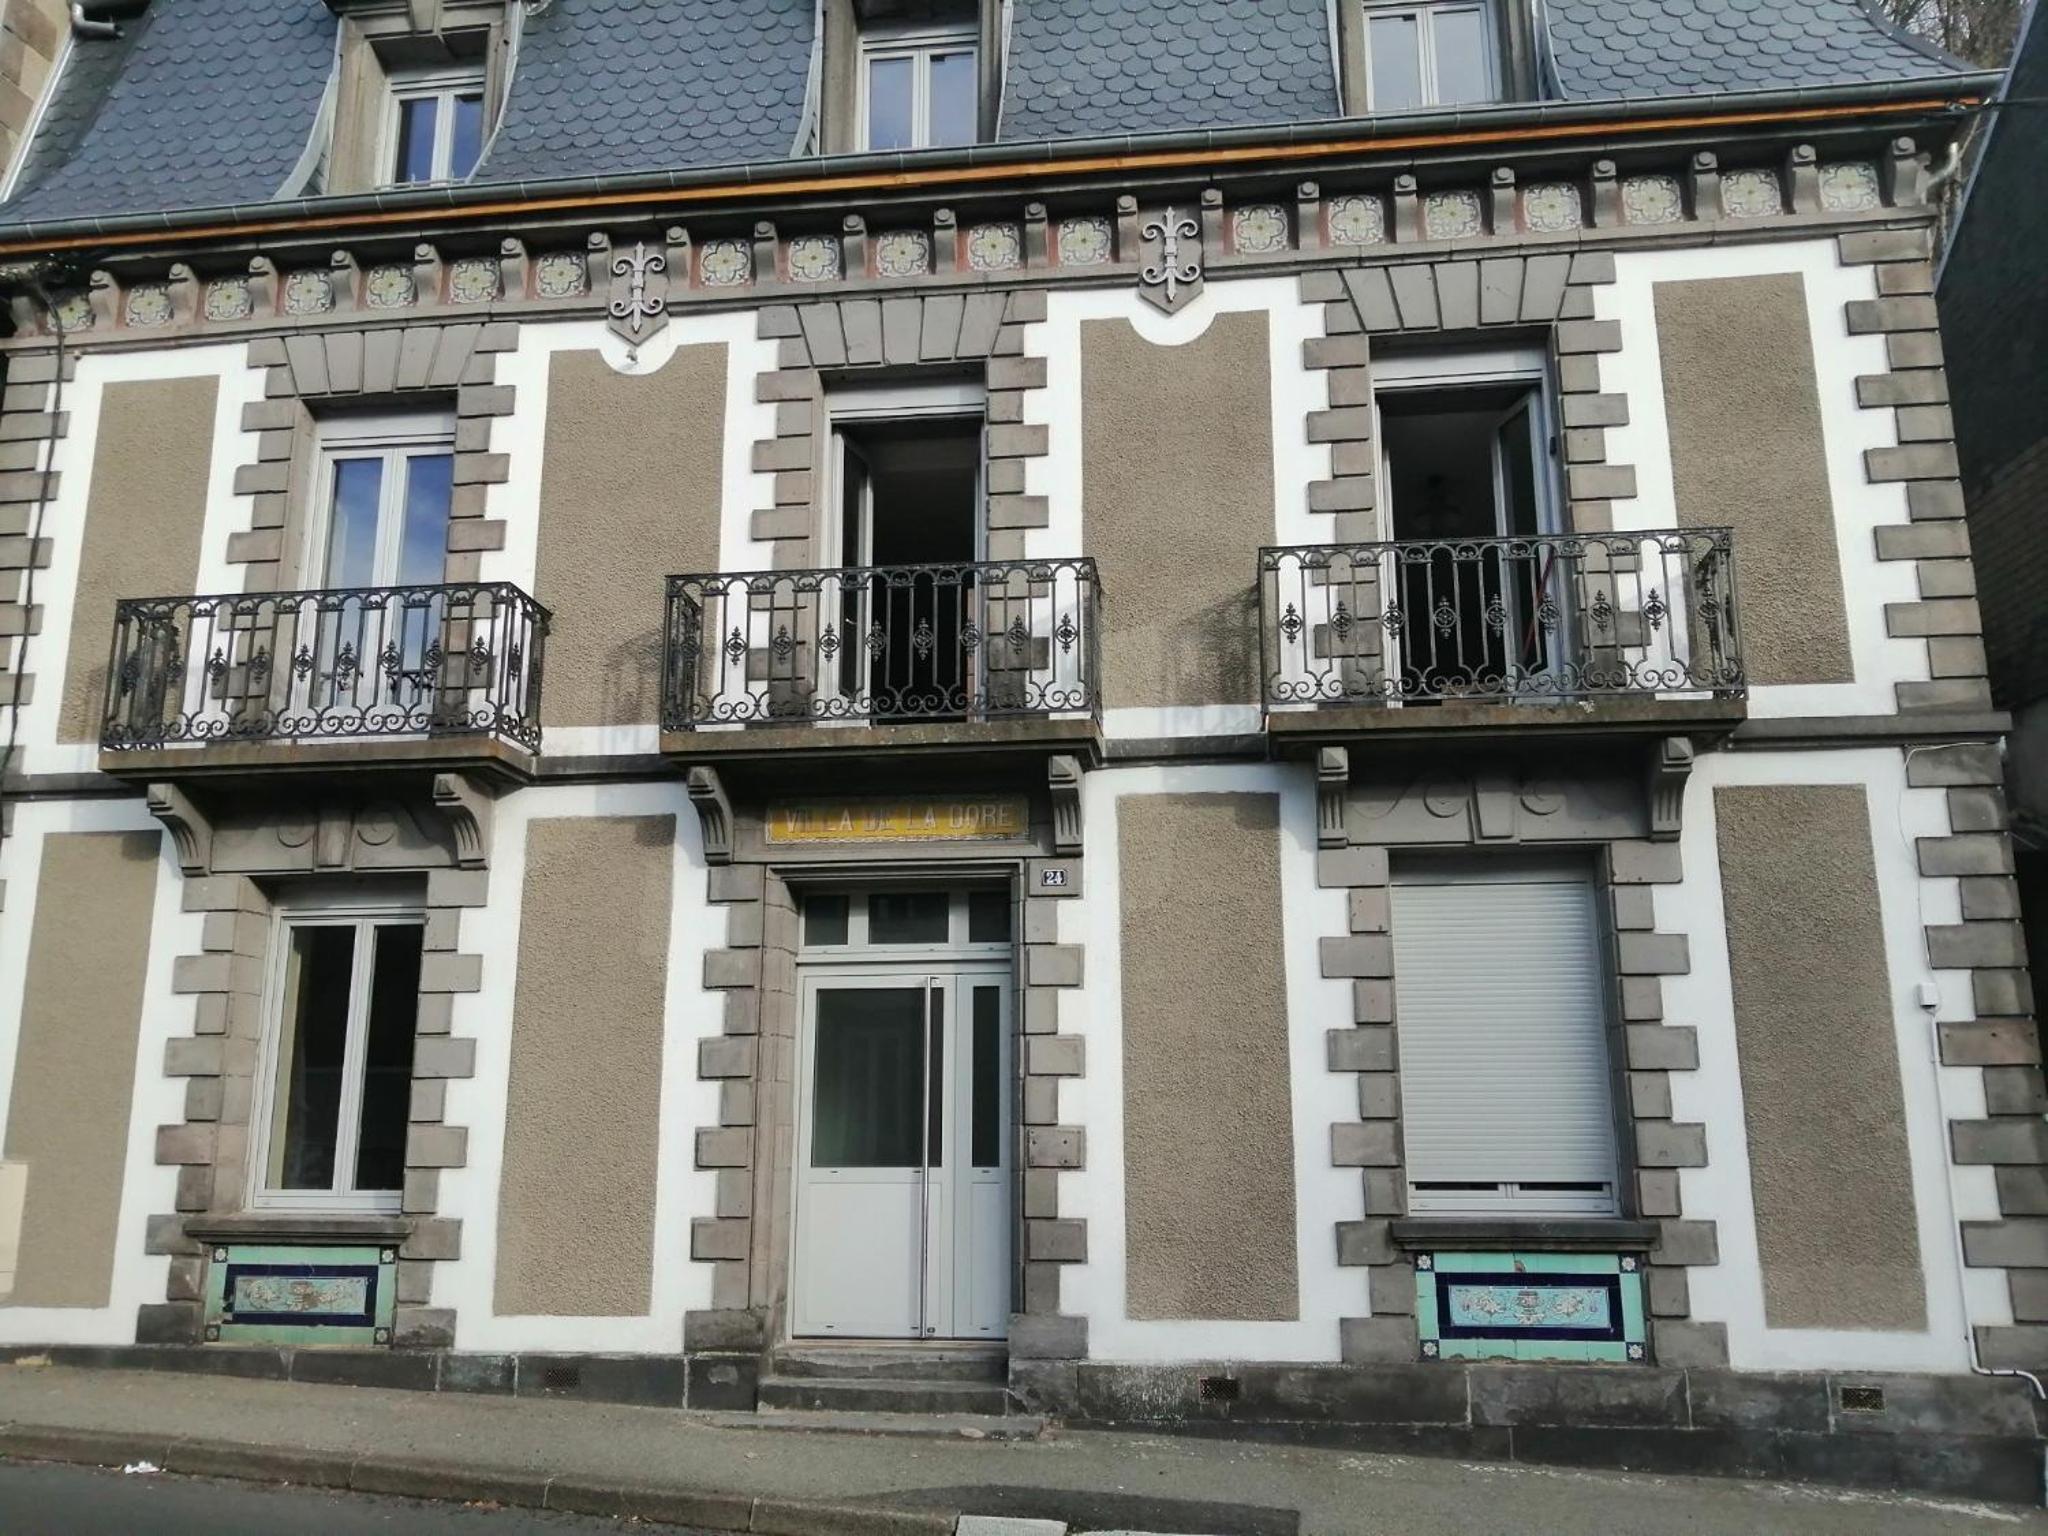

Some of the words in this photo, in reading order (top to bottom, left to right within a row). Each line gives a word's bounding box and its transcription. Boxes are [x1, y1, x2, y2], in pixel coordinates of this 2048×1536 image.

[785, 807, 854, 833] VILLA
[863, 807, 897, 832] DE
[906, 805, 936, 830] LA
[1046, 871, 1063, 884] 24
